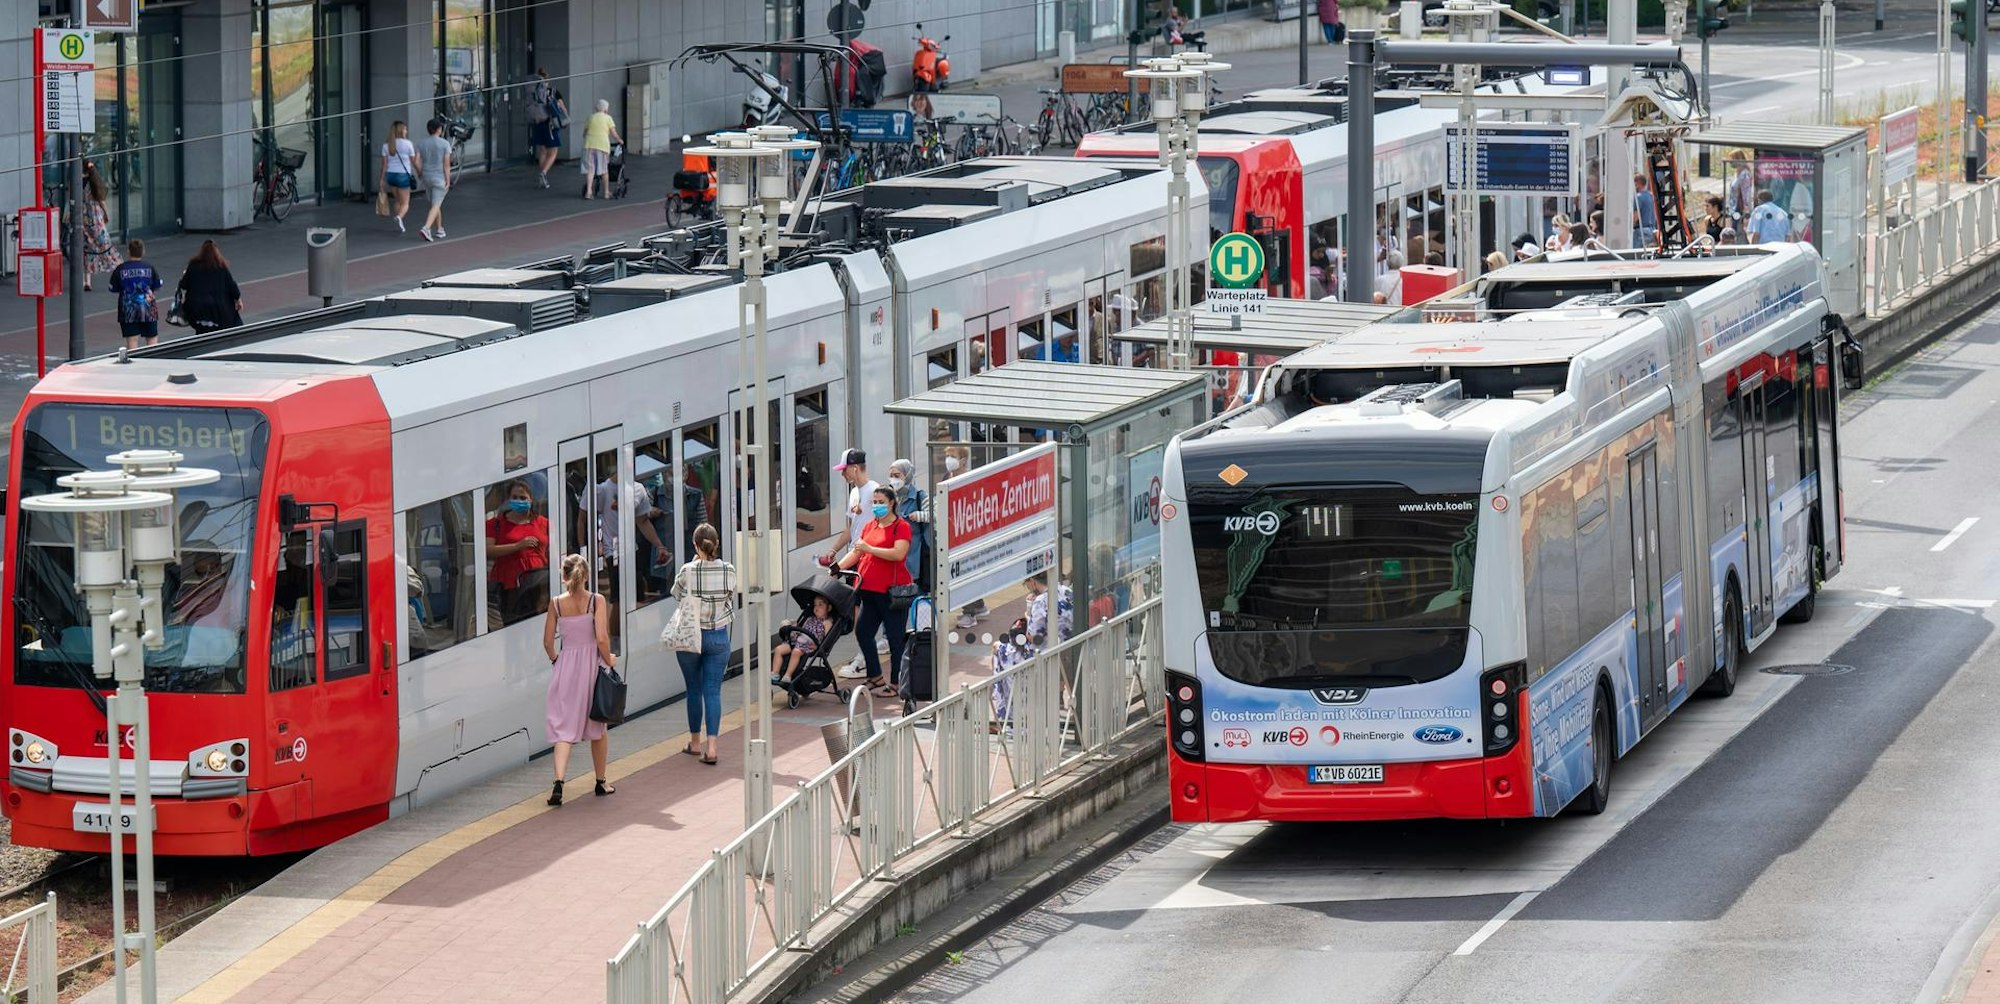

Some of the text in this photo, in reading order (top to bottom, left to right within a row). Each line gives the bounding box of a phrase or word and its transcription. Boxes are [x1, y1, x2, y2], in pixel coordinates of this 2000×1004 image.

[1225, 246, 1249, 275] H
[1207, 290, 1266, 302] Warteplatz
[1212, 304, 1261, 313] Linie 141
[67, 413, 246, 456] 1 Bensberg
[953, 473, 1050, 537] Weiden Zentrum
[1134, 491, 1150, 524] KVB
[1399, 501, 1473, 512] www.kvb.koeln
[1224, 516, 1256, 531] KVB
[1320, 690, 1358, 700] VDL
[1211, 706, 1471, 721] Ökostrom laden mit Kölner Innovation
[95, 730, 124, 744] KB
[1263, 732, 1288, 742] KVB
[1344, 732, 1404, 741] RheinEnergie
[1422, 727, 1454, 741] Ford
[275, 746, 292, 762] KVB
[1316, 768, 1381, 780] K VB 6021E
